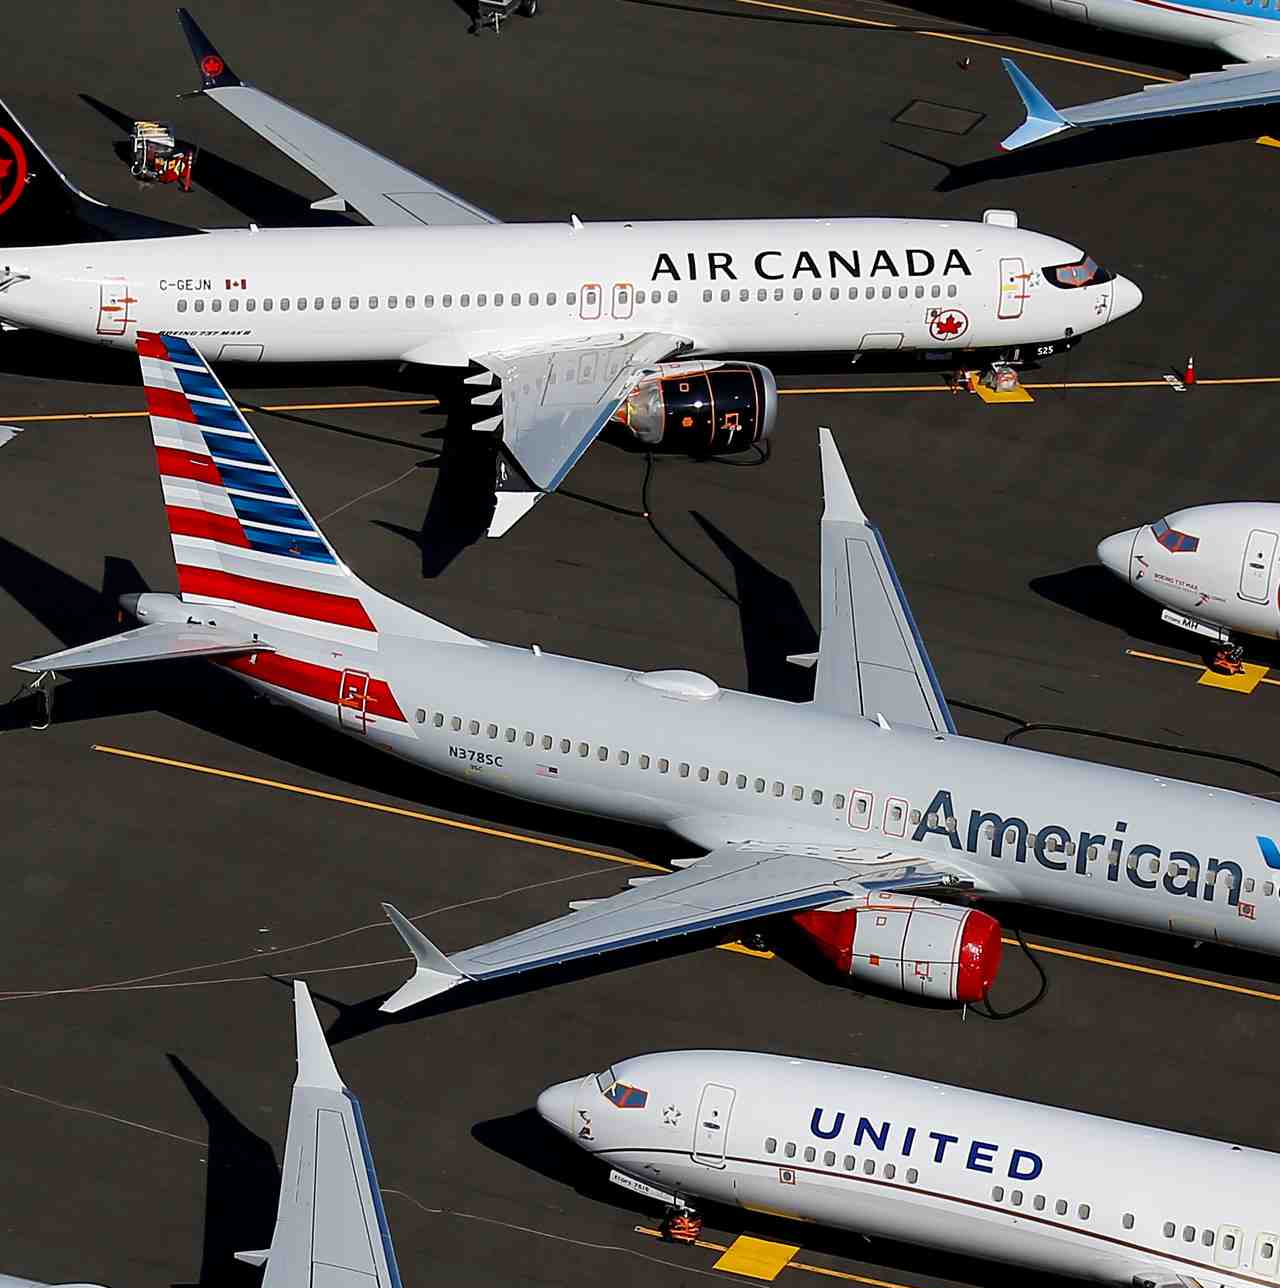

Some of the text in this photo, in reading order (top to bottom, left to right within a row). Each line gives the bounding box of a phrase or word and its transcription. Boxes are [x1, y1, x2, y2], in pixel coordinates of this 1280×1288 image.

[651, 248, 973, 281] AIR CANADA
[159, 279, 212, 291] C-GEJN
[1037, 345, 1054, 356] 525
[1182, 618, 1199, 631] MH
[448, 745, 504, 768] N378SC
[910, 789, 1243, 907] American
[809, 1107, 1044, 1182] UNITED
